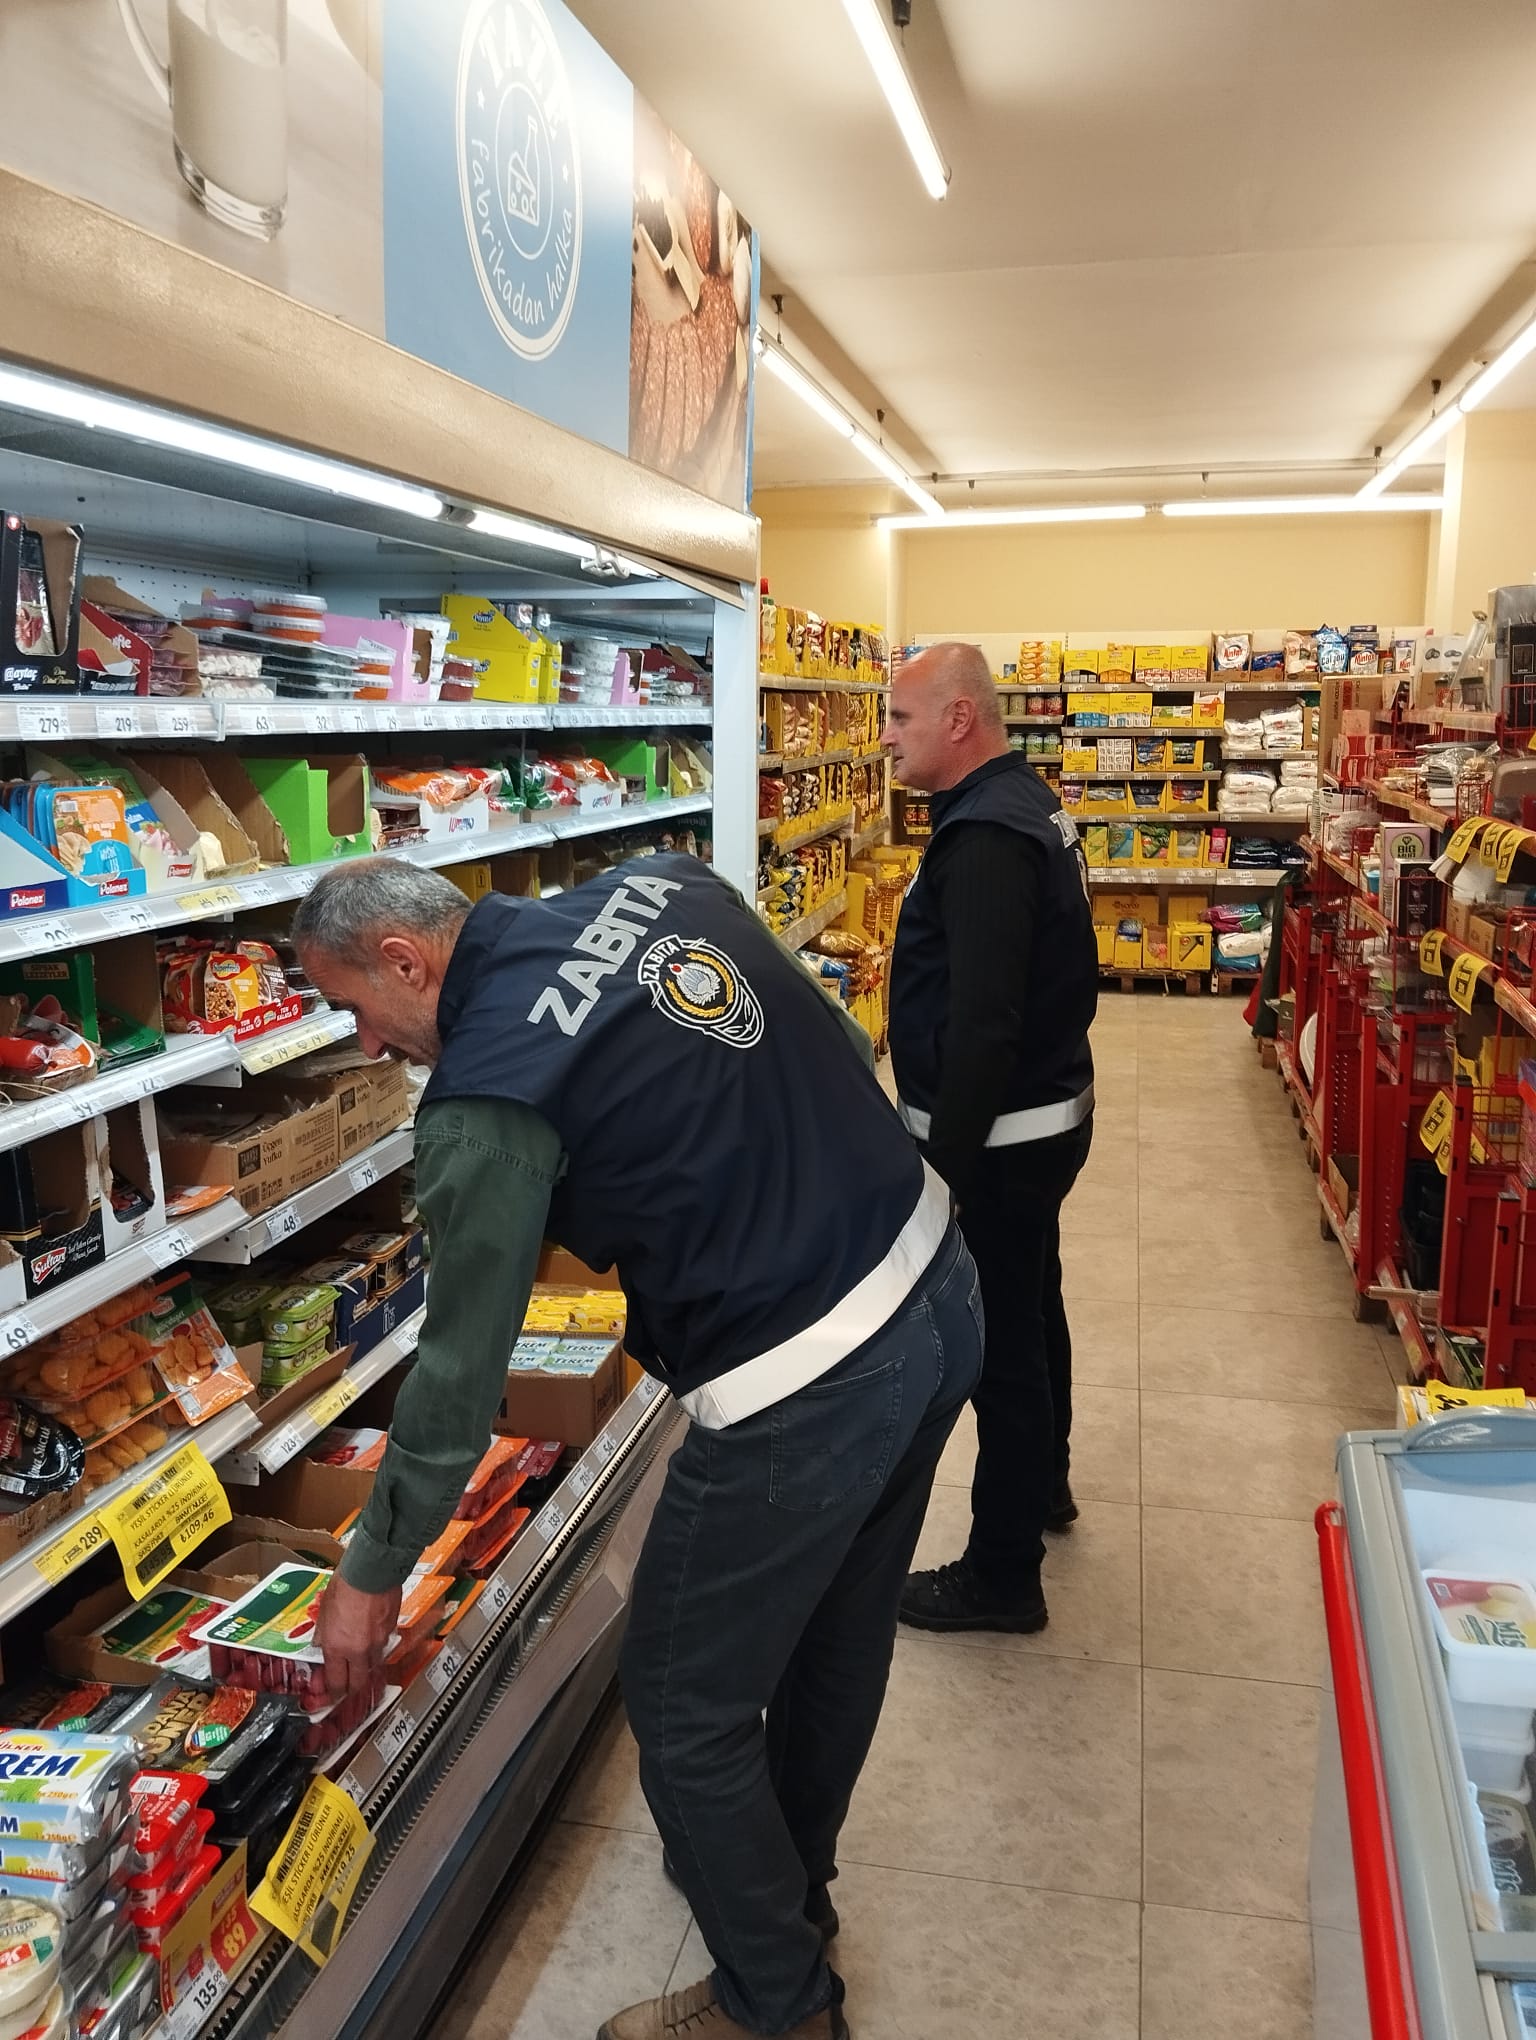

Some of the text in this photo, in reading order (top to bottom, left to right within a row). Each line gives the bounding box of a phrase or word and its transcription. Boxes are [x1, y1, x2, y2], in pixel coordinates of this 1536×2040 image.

[471, 138, 573, 325] fabrikadan halka
[39, 717, 60, 733] 279
[115, 717, 132, 732] 219
[11, 893, 44, 908] Polonez
[100, 882, 128, 896] Polonez
[526, 875, 684, 1037] ZABITA
[643, 940, 681, 982] ZABITA
[262, 1137, 284, 1154] Üçgen
[263, 1150, 283, 1167] Yufka
[361, 1168, 374, 1185] 79
[283, 1215, 297, 1234] 48
[168, 1238, 189, 1258] 37
[34, 1251, 66, 1279] Sultan
[6, 1327, 27, 1349] 69
[1, 1432, 17, 1460] NAMET
[280, 1437, 297, 1455] 123
[130, 1512, 146, 1531] YEŞİL
[145, 1494, 169, 1518] STİCKER
[172, 1469, 194, 1493] ÜRÜNLER
[134, 1515, 166, 1549] KASALARDA
[166, 1501, 180, 1518] %25
[180, 1508, 215, 1543] ₺109,46
[79, 1525, 103, 1550] 289
[493, 1588, 507, 1608] 69
[441, 1655, 458, 1678] 82
[142, 1690, 197, 1735] DANA
[391, 1720, 408, 1743] 199
[0, 1753, 81, 1780] REM
[298, 1809, 313, 1828] ÖZEL
[280, 1883, 295, 1904] EŞİL
[288, 1849, 311, 1885] STİCKER
[308, 1802, 332, 1842] ÜRÜNLER
[222, 1922, 247, 1960] 89
